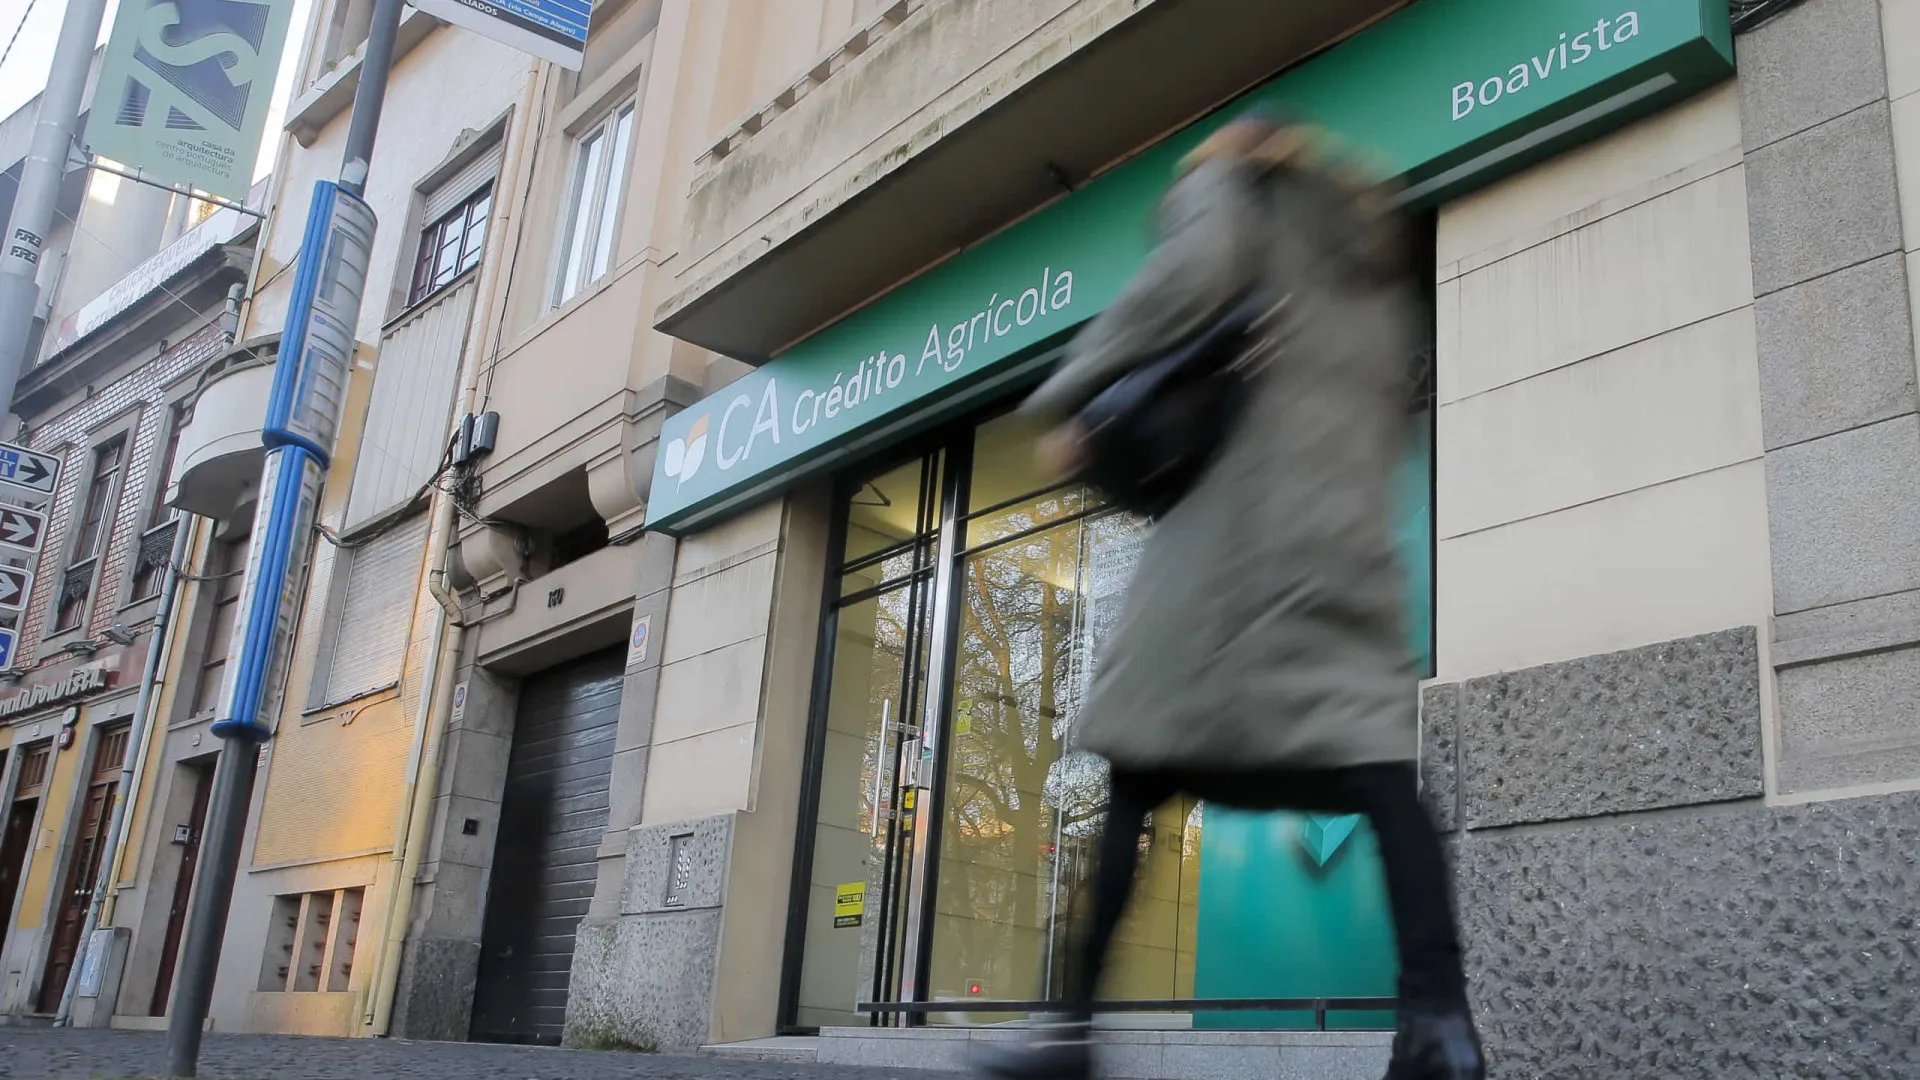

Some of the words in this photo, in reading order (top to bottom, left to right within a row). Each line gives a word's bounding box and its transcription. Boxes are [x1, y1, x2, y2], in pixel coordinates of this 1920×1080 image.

[523, 8, 549, 23] Campo
[549, 19, 576, 36] Alegre)
[1452, 10, 1639, 121] Boavista
[156, 140, 185, 155] centro
[177, 139, 234, 164] arquitectura
[202, 140, 222, 152] casa
[223, 147, 235, 156] da
[162, 150, 174, 160] de
[176, 156, 230, 178] arquitectura
[715, 377, 780, 470] CA
[791, 349, 906, 436] Crédito
[915, 265, 1075, 374] Agrícola
